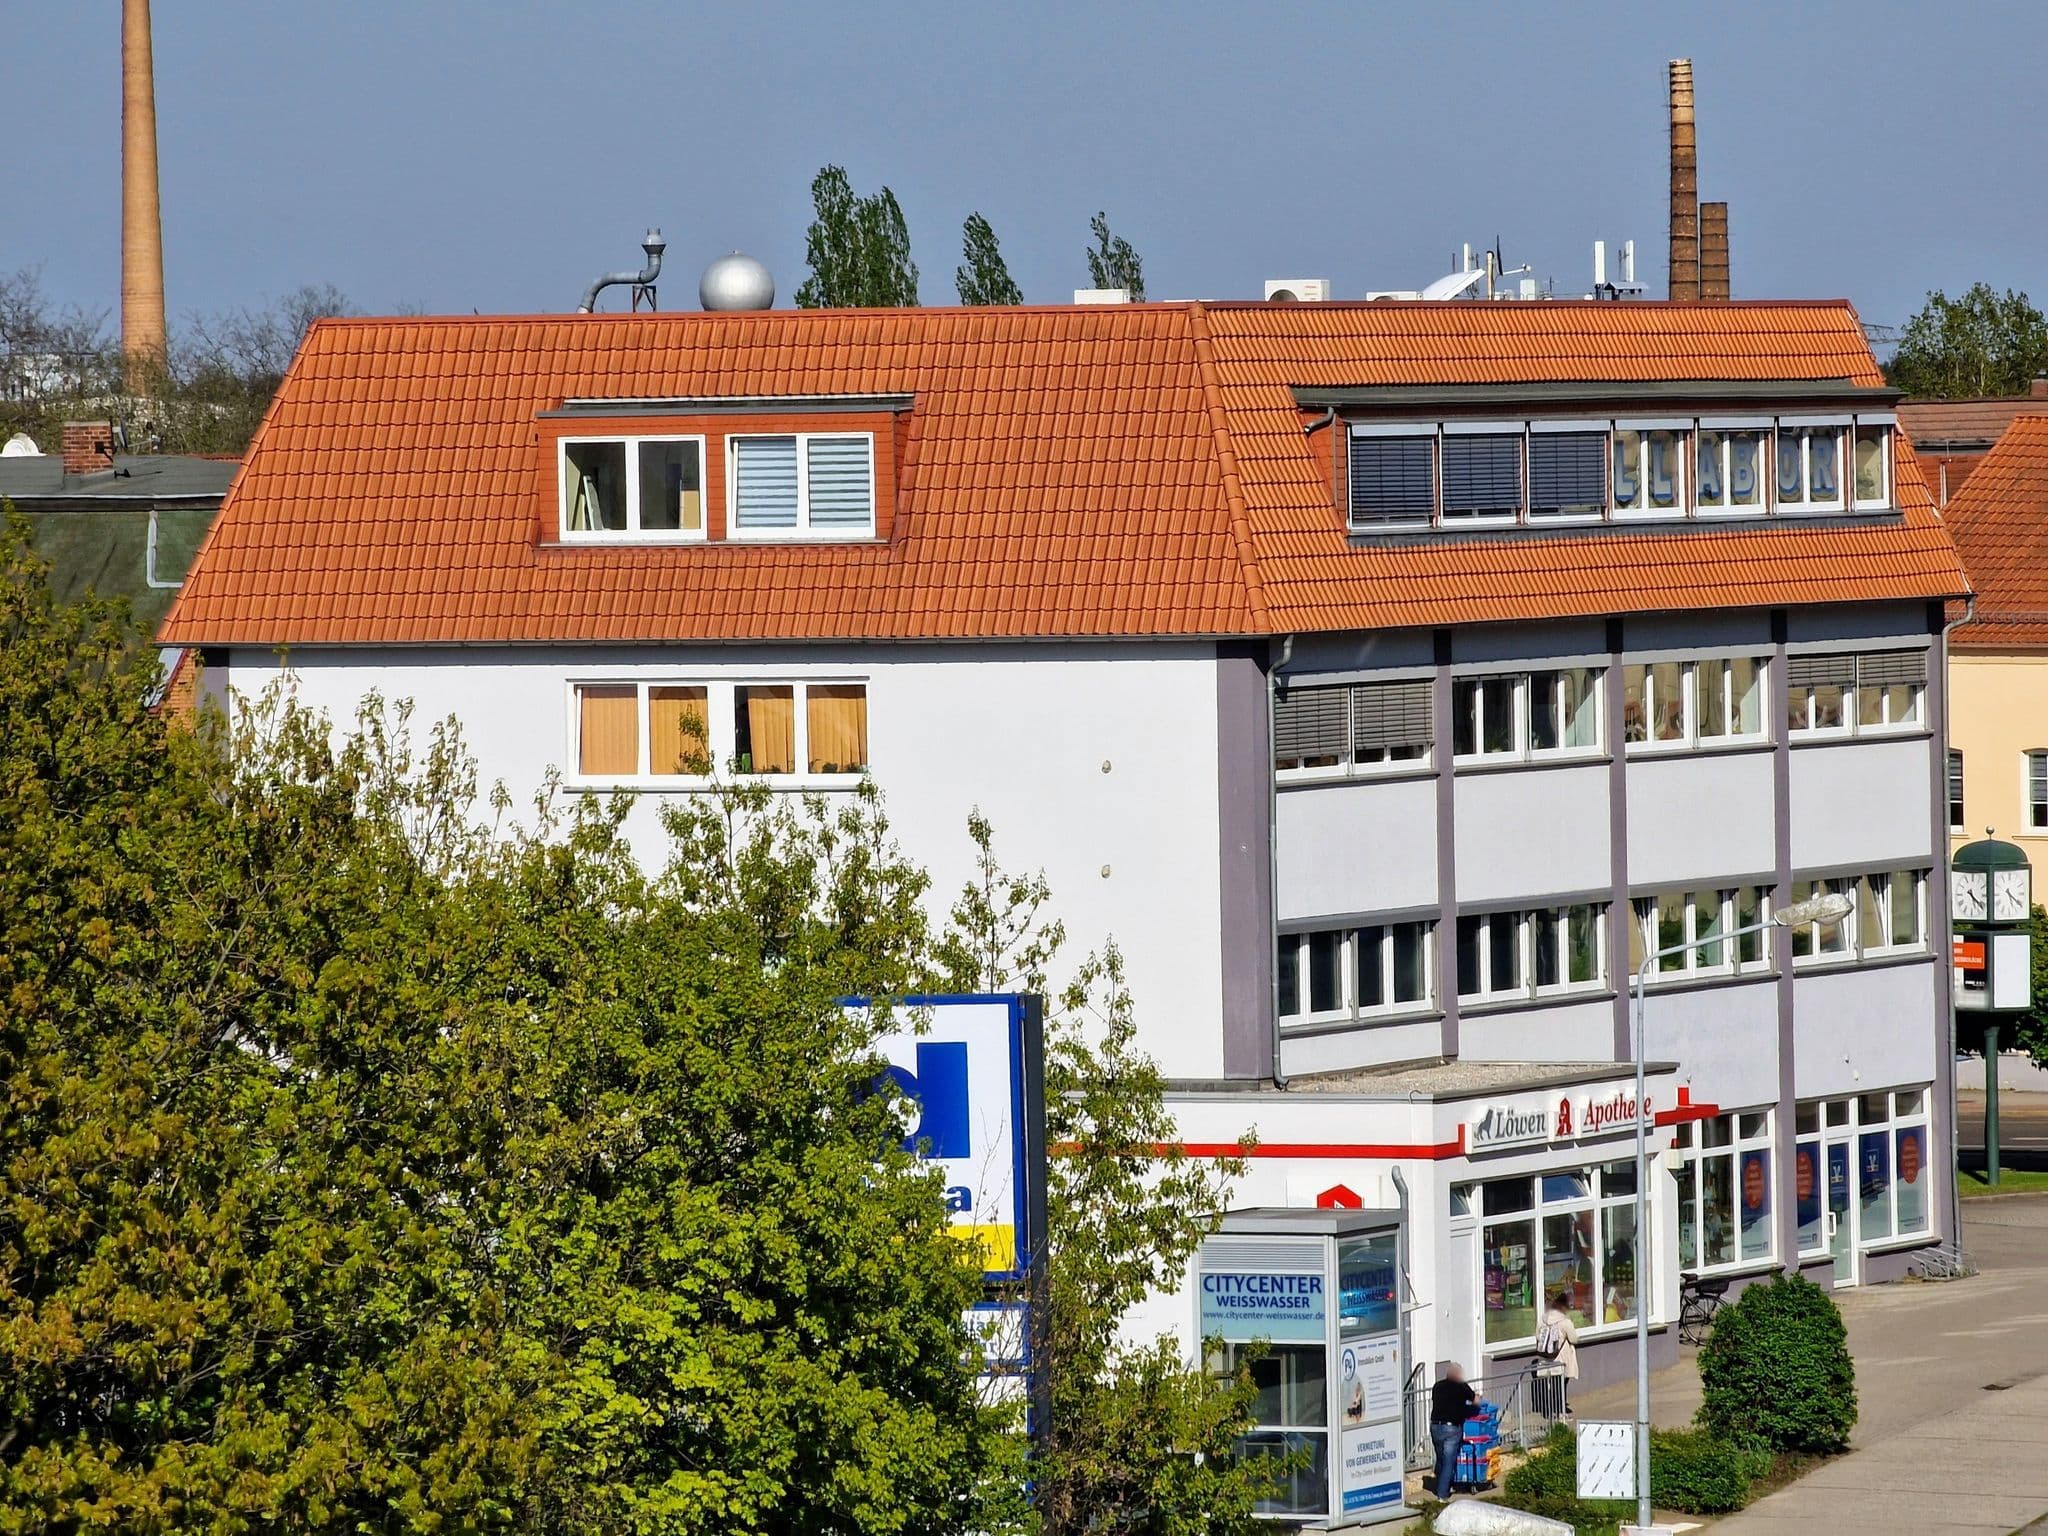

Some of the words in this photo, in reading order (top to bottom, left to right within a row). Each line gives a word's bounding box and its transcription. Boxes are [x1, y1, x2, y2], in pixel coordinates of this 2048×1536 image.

[1495, 1107, 1546, 1139] Löwen
[1584, 1092, 1652, 1132] Apothee
[1203, 1275, 1322, 1294] CITYCENTER
[1216, 1295, 1310, 1308] WEISSWASSER
[1203, 1311, 1325, 1321] www.citycenter-weisswasser.de
